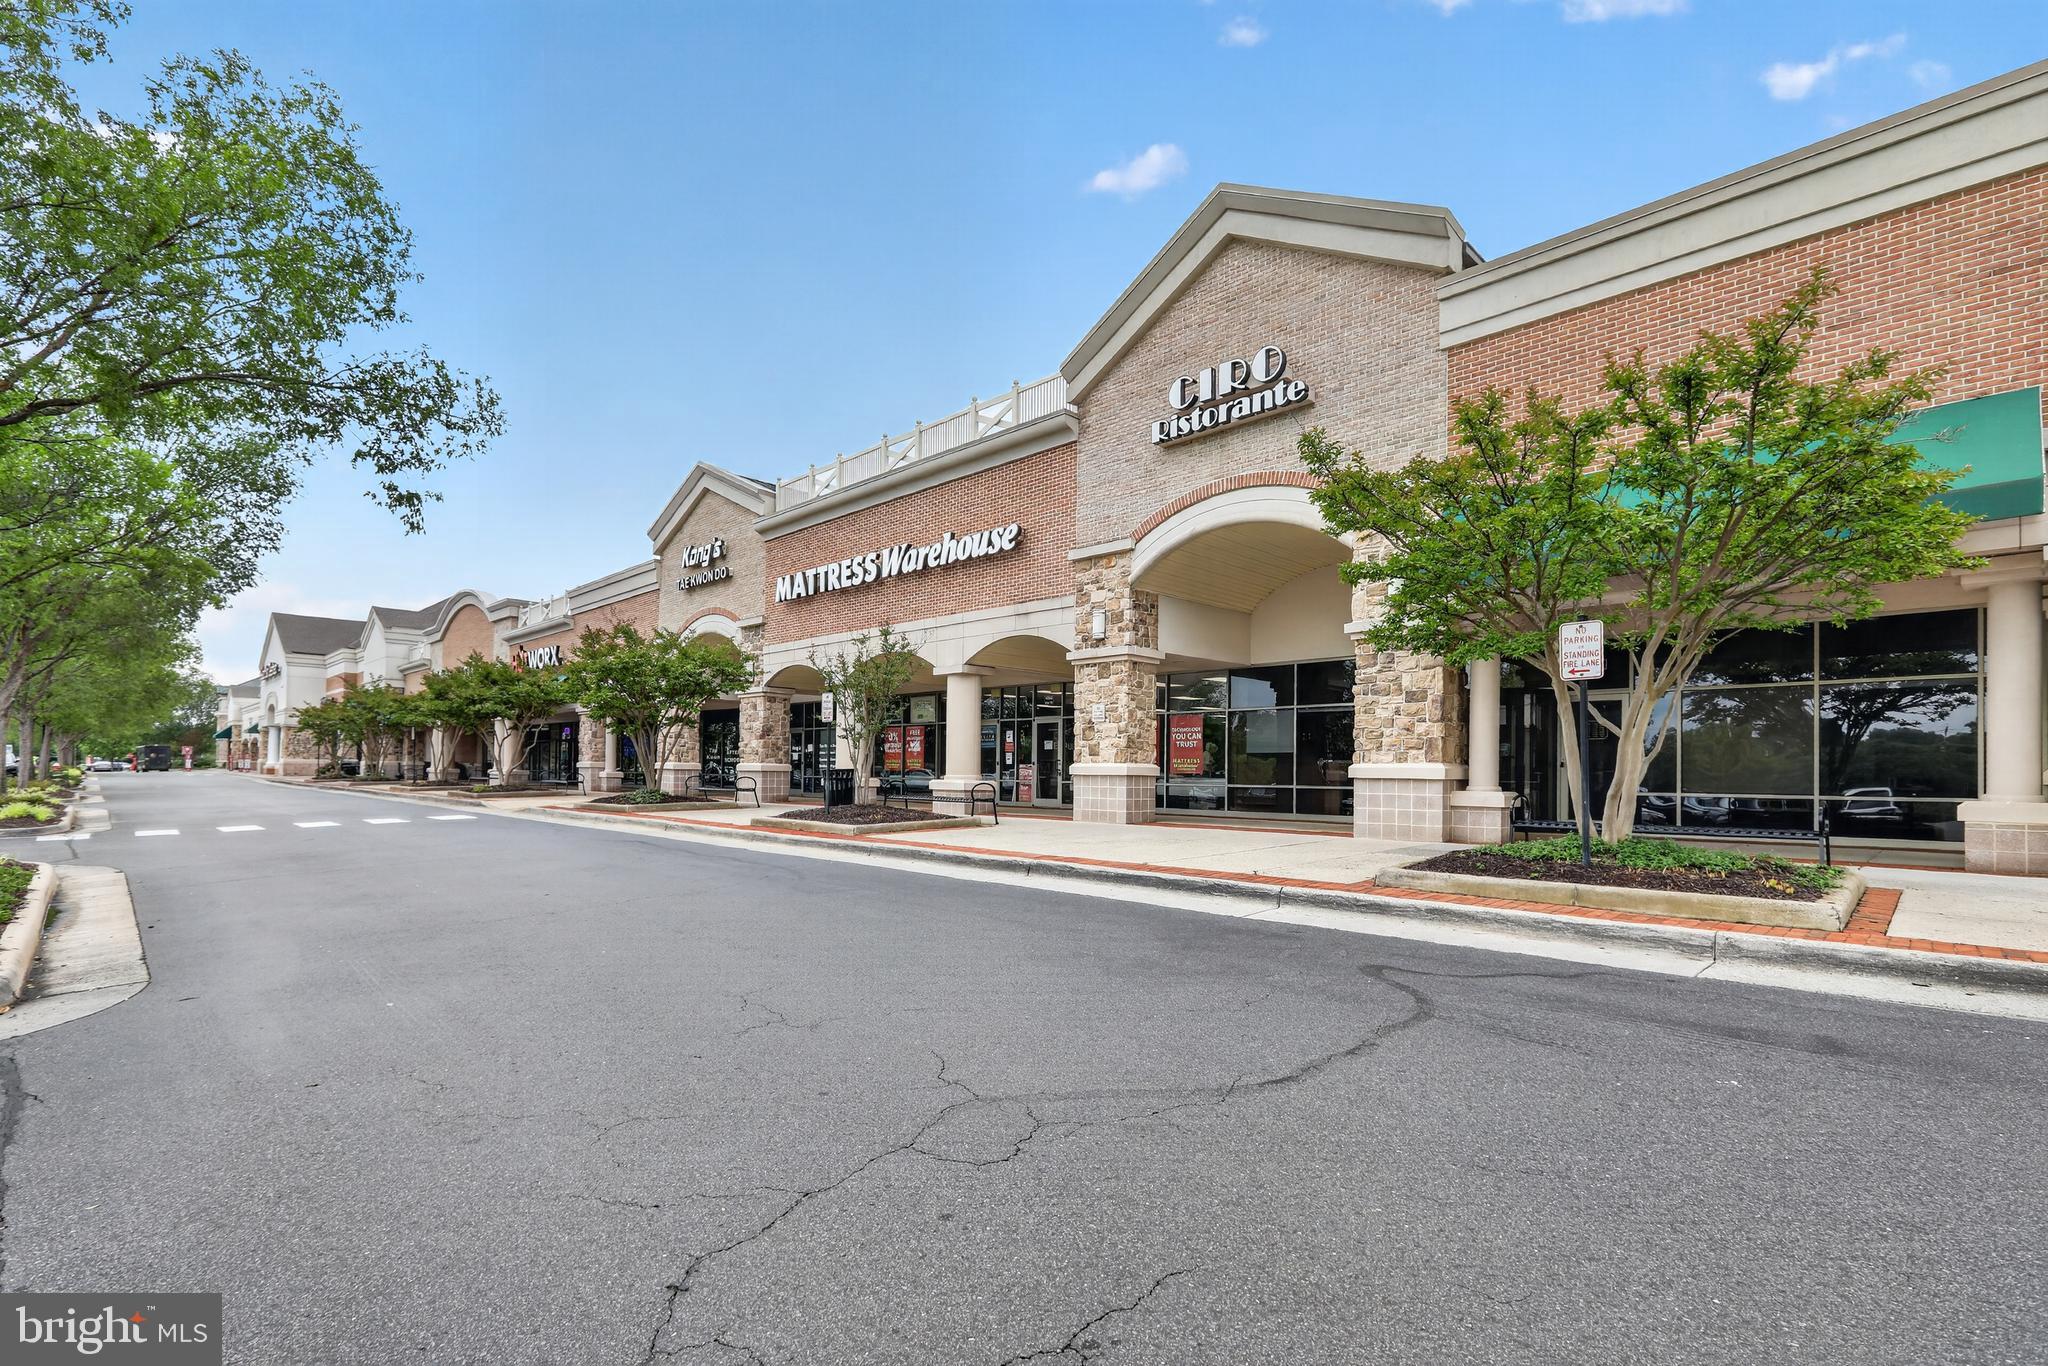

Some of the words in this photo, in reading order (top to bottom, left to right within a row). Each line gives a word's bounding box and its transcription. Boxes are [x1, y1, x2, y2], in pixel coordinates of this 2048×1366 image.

[1168, 345, 1284, 410] CIRO
[1151, 380, 1308, 444] Ristorante
[775, 553, 878, 602] MATTRESS
[880, 523, 1020, 577] Warehouse
[1575, 626, 1587, 634] NO
[1563, 635, 1599, 645] PARKING
[1563, 649, 1600, 660] STANDING
[1563, 660, 1579, 668] FIRE
[1581, 658, 1600, 667] LANE
